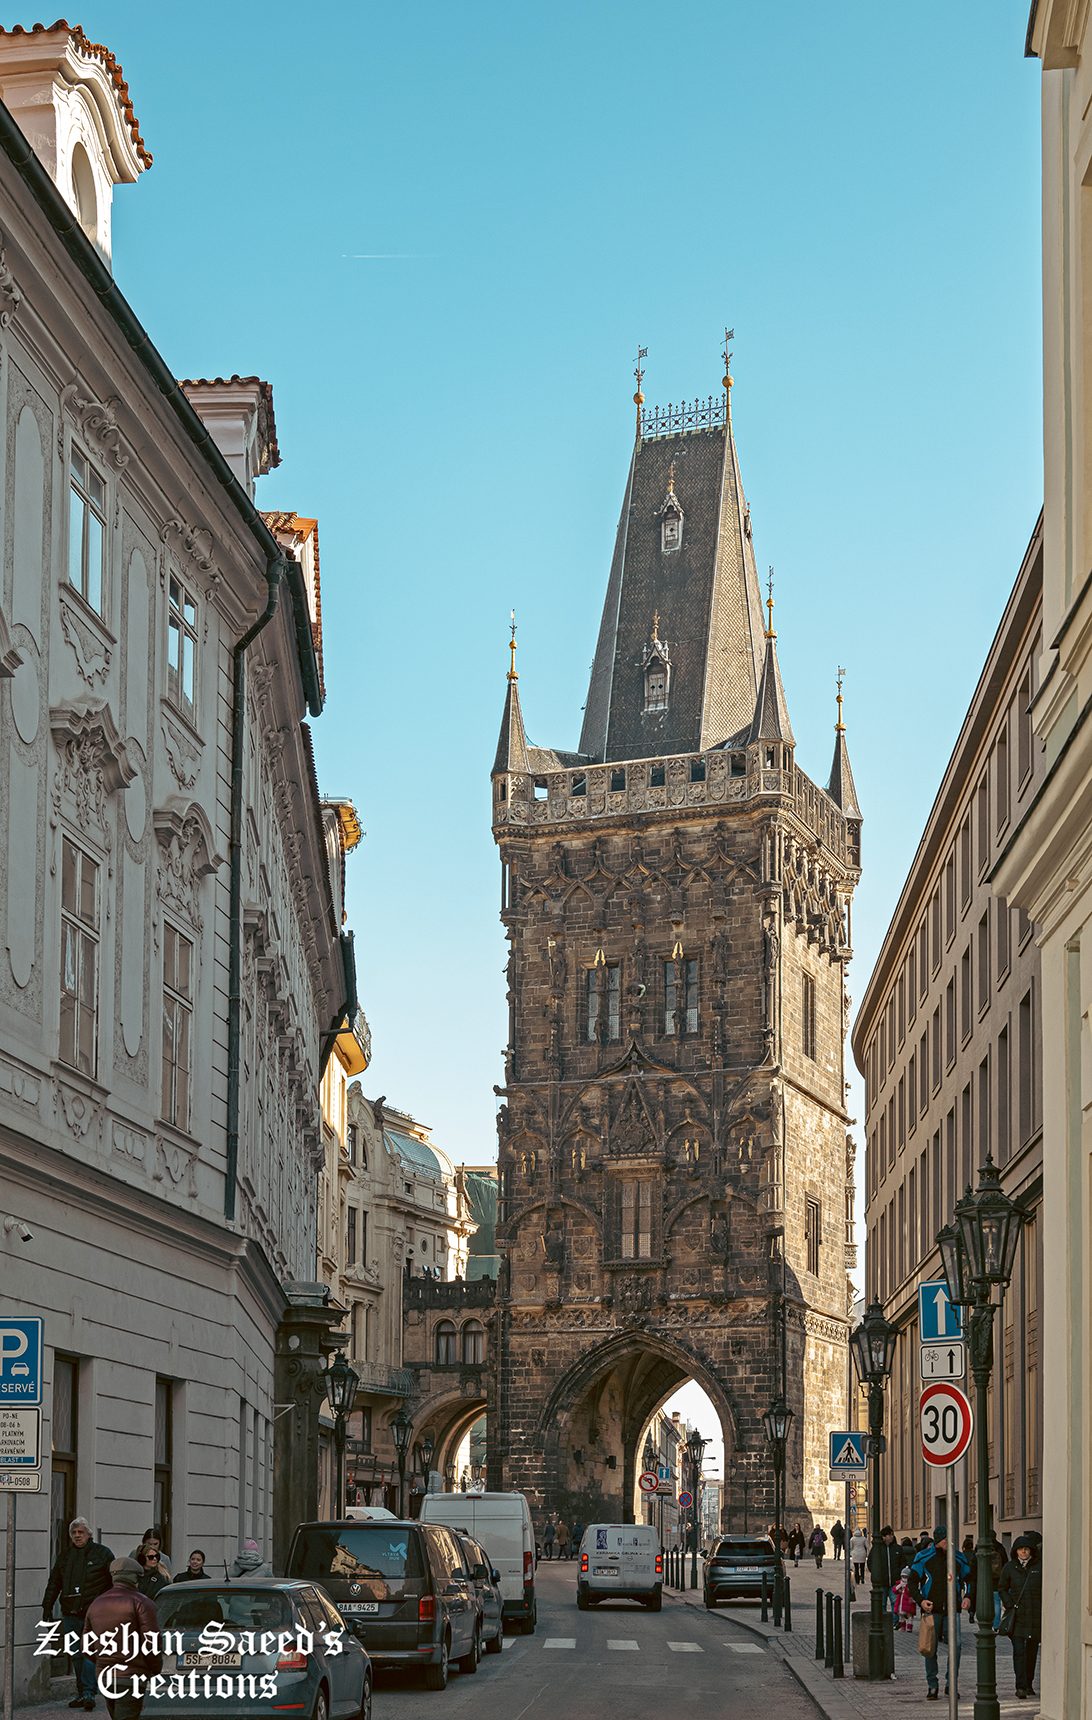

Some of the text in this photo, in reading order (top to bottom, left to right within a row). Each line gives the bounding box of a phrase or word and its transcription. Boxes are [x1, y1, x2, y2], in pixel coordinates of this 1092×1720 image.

[0, 1328, 28, 1376] P
[0, 1381, 35, 1393] SERVÉ
[924, 1405, 957, 1443] 30
[357, 1603, 376, 1611] 9425
[211, 1654, 237, 1665] 8084
